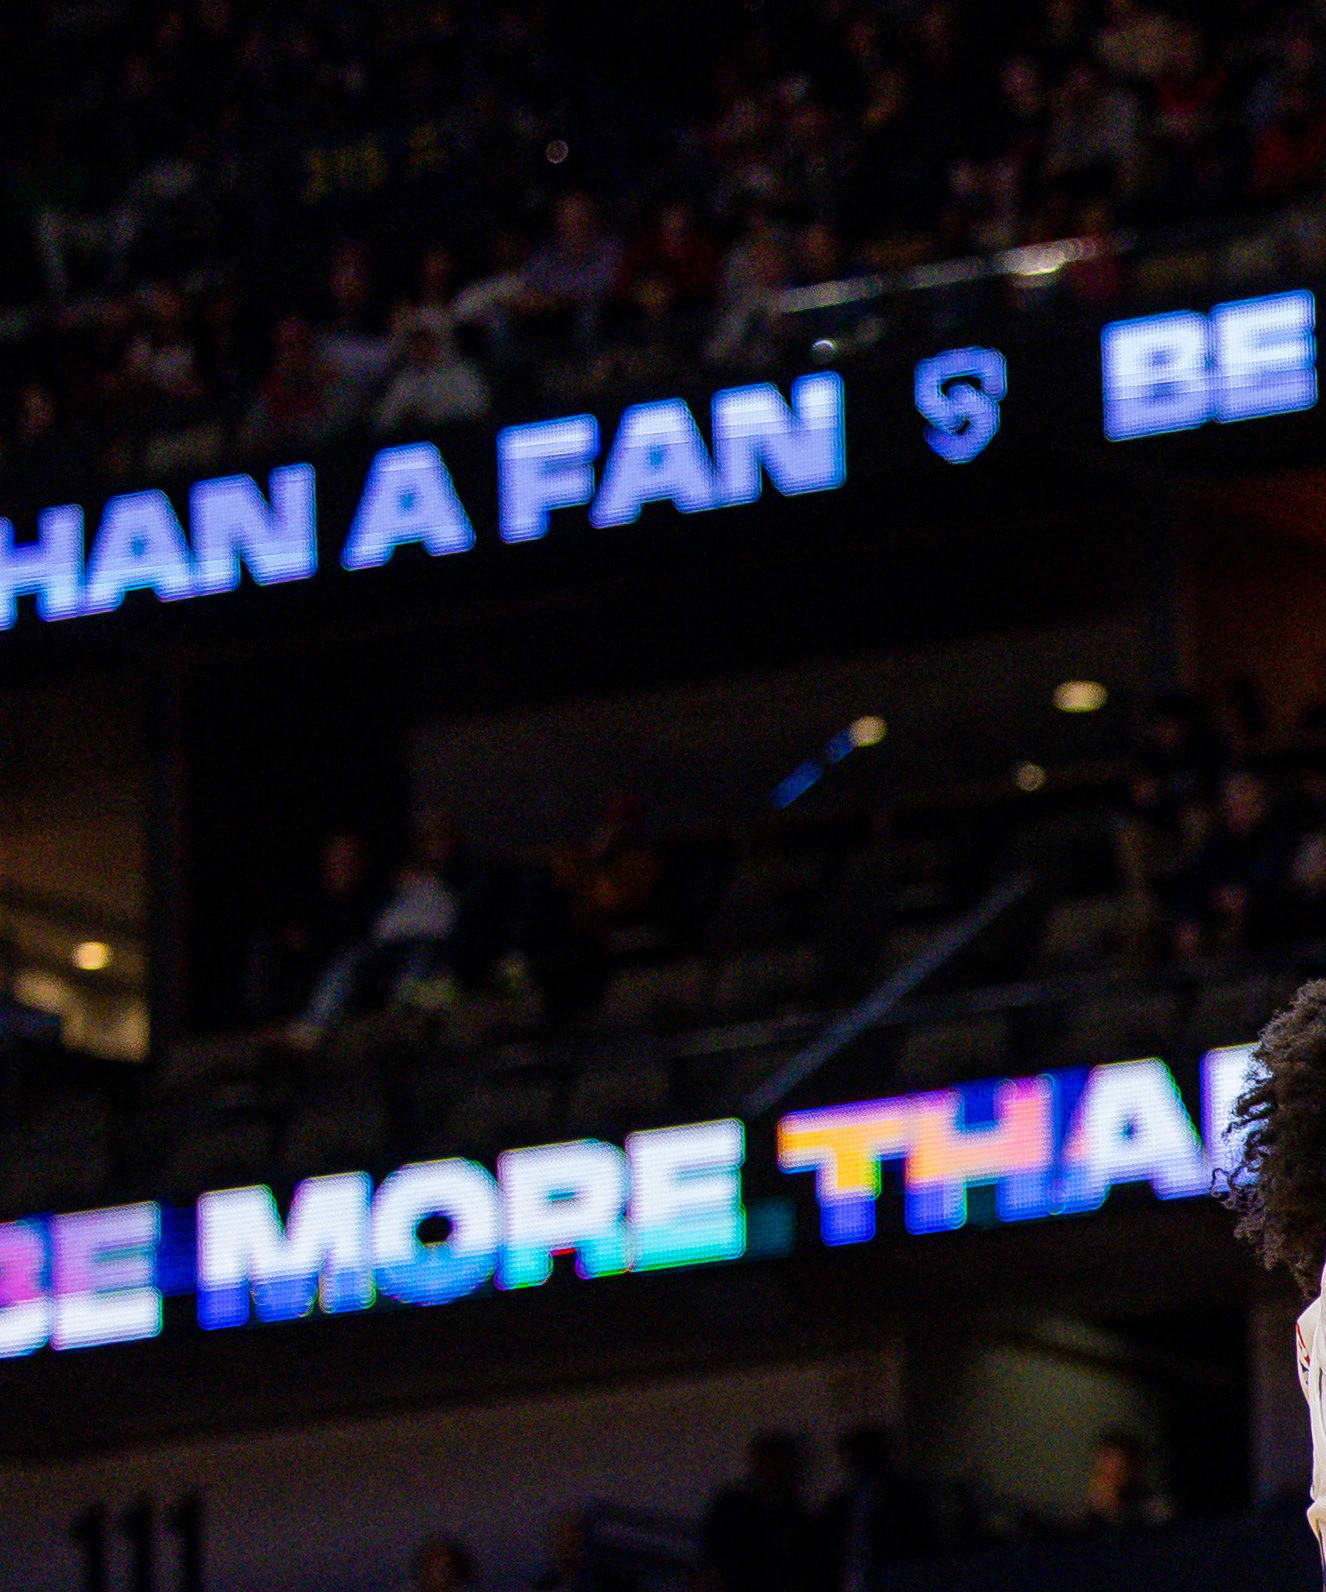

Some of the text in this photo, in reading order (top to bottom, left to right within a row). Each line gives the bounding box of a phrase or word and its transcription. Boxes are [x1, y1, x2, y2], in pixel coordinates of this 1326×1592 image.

[1101, 289, 1318, 442] BE
[0, 370, 846, 631] HAN A FAN
[197, 1117, 746, 1330] MORE
